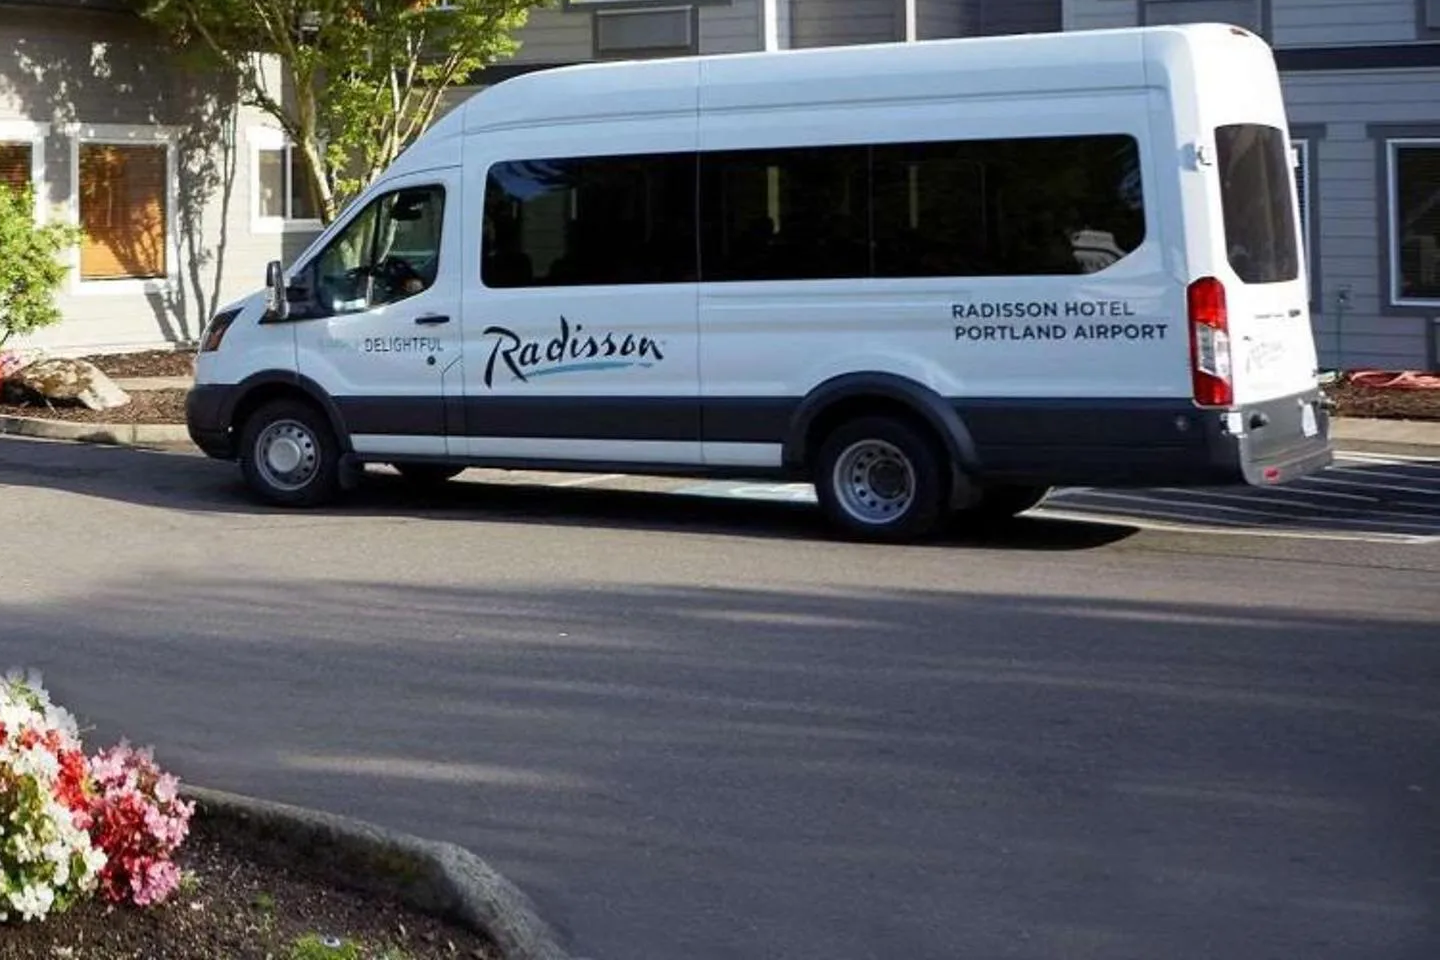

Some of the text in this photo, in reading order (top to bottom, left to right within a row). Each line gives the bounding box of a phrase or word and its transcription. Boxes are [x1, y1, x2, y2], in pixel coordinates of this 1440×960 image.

[951, 301, 1136, 319] RADISSON HOTEL
[954, 323, 1170, 341] PORTLAND AIRPORT
[364, 337, 444, 353] DELIGHTFUL
[482, 313, 665, 389] Radisson
